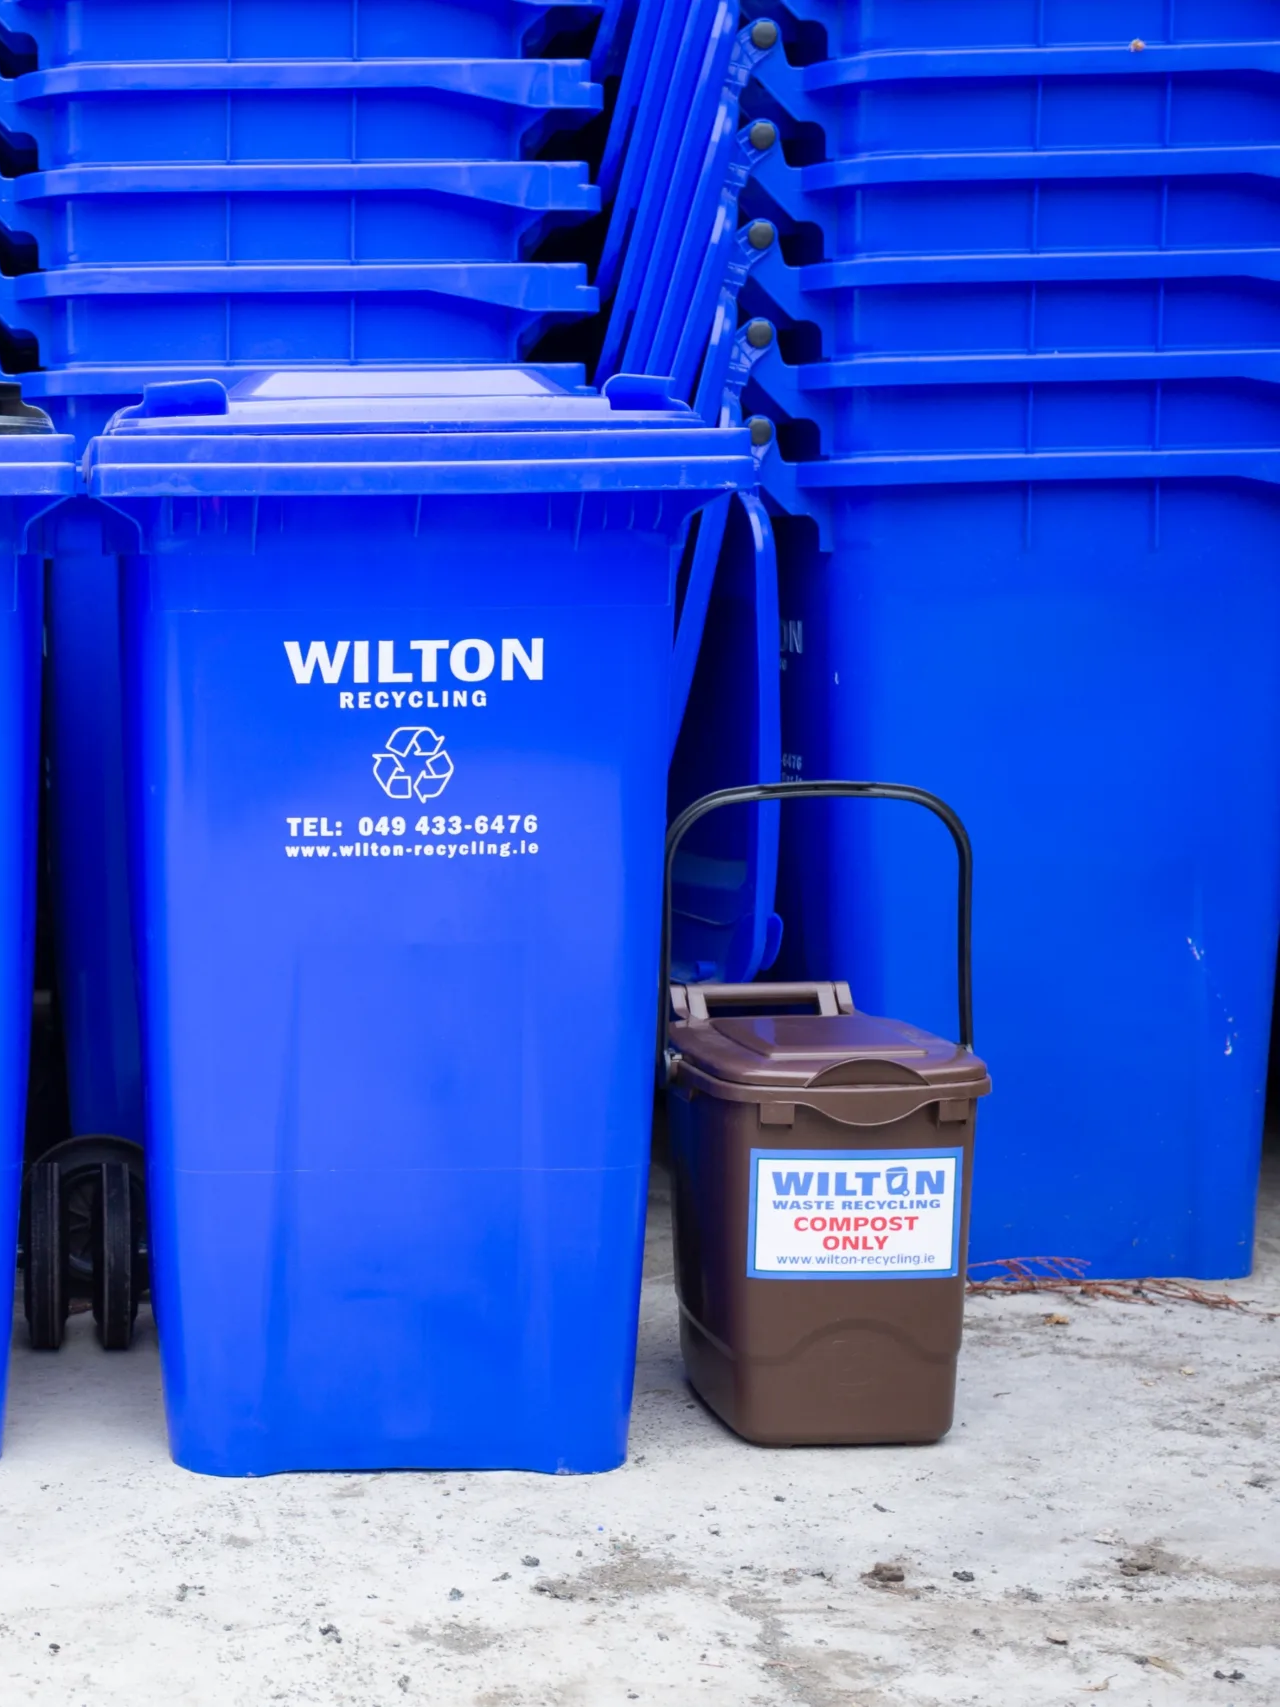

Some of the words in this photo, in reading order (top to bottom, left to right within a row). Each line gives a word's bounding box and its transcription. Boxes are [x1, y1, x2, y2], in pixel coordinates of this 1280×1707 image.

[284, 638, 543, 683] WILTON
[340, 690, 486, 708] RECYCLING
[287, 817, 342, 836] TEL:
[359, 816, 405, 836] 049
[415, 815, 537, 835] 433-6476
[285, 840, 538, 858] www.wilton-recycling.ie
[772, 1166, 945, 1196] WILTON
[773, 1201, 834, 1210] WASTE
[842, 1199, 940, 1210] RECYCLING
[794, 1216, 918, 1231] COMPOST
[823, 1236, 888, 1250] ONLY
[777, 1255, 934, 1265] www.wilton-recycling.ie
